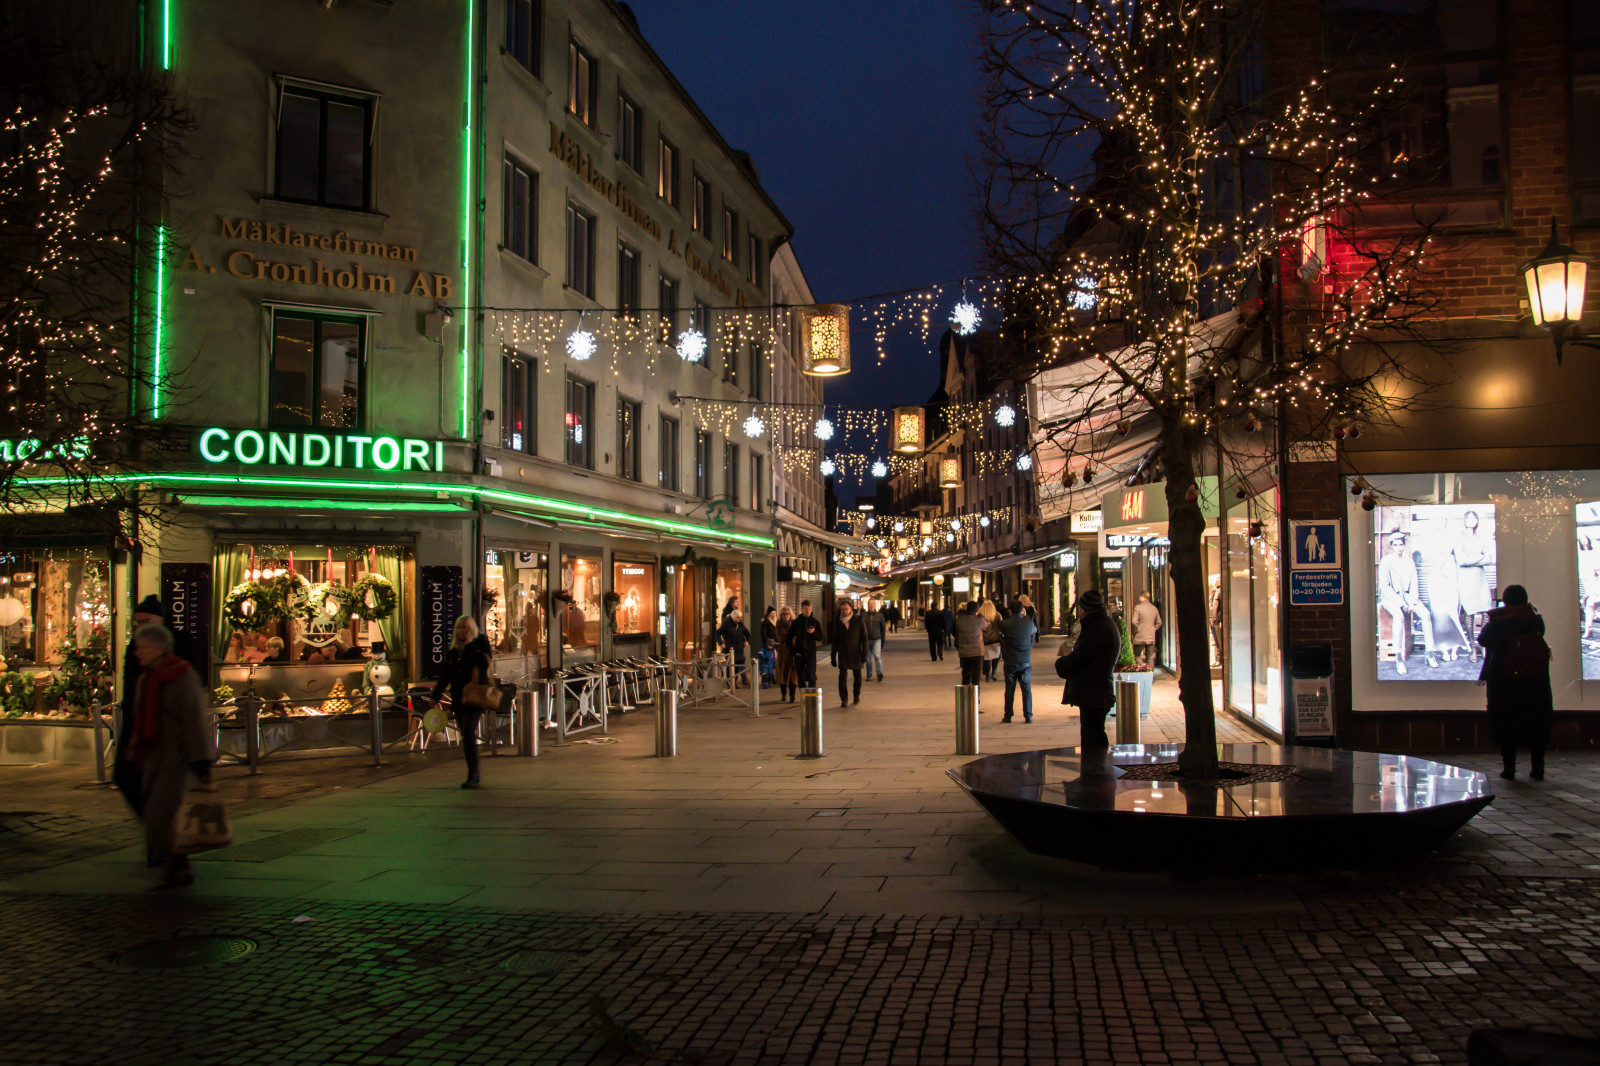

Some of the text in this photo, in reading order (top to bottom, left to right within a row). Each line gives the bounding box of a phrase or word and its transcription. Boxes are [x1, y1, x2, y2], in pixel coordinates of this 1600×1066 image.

[549, 121, 661, 243] Mäklarefirman
[219, 215, 419, 263] Mäklarefirman
[179, 244, 454, 299] A. Cronholm AB
[199, 427, 445, 473] CONDITORI
[1122, 490, 1144, 520] H&M
[432, 582, 443, 664] CRONHOLM
